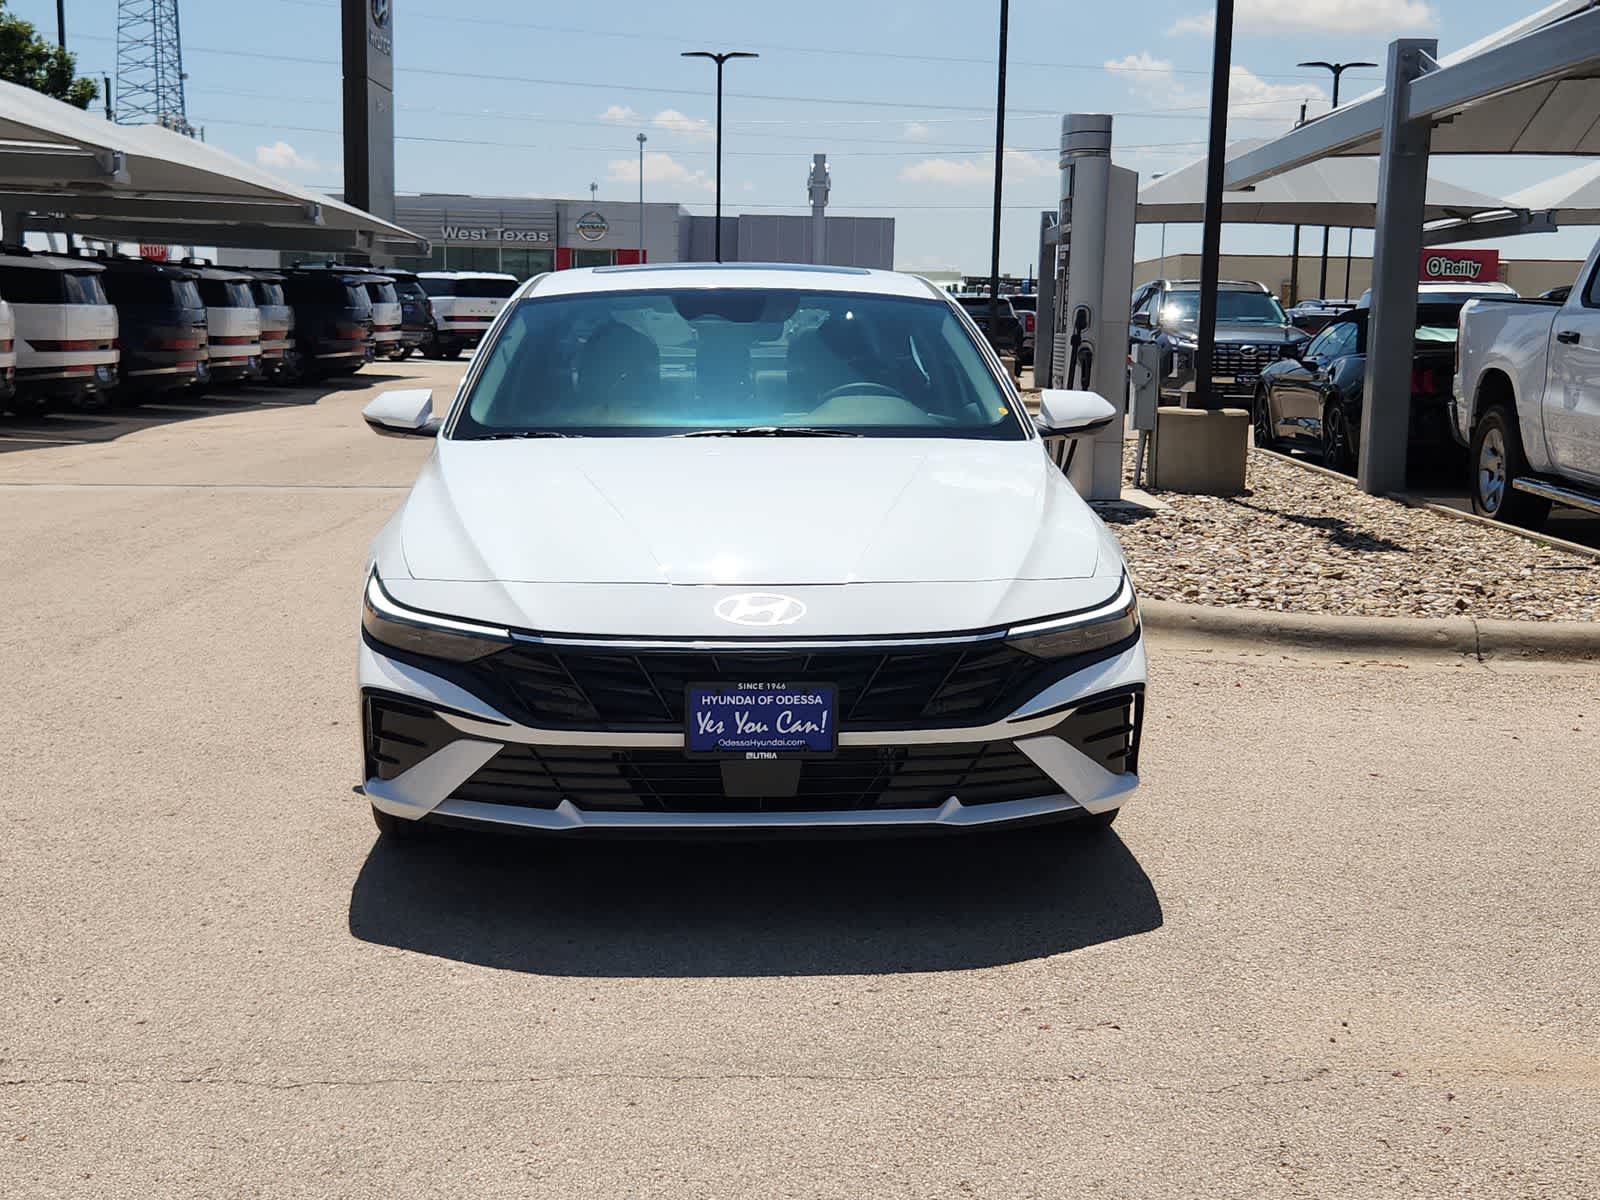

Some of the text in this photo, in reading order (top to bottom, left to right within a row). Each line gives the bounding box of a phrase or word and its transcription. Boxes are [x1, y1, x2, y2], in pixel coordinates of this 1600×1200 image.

[441, 226, 550, 242] West Texas
[141, 244, 167, 257] STOP
[1427, 257, 1481, 279] O'Reilly
[737, 682, 787, 690] SINCE 1946
[701, 695, 823, 705] HYUNDAI OF ODESSA
[696, 710, 828, 735] Yes You Can!
[718, 738, 806, 747] OdessaHyundai.com
[753, 752, 778, 760] LITHIA
